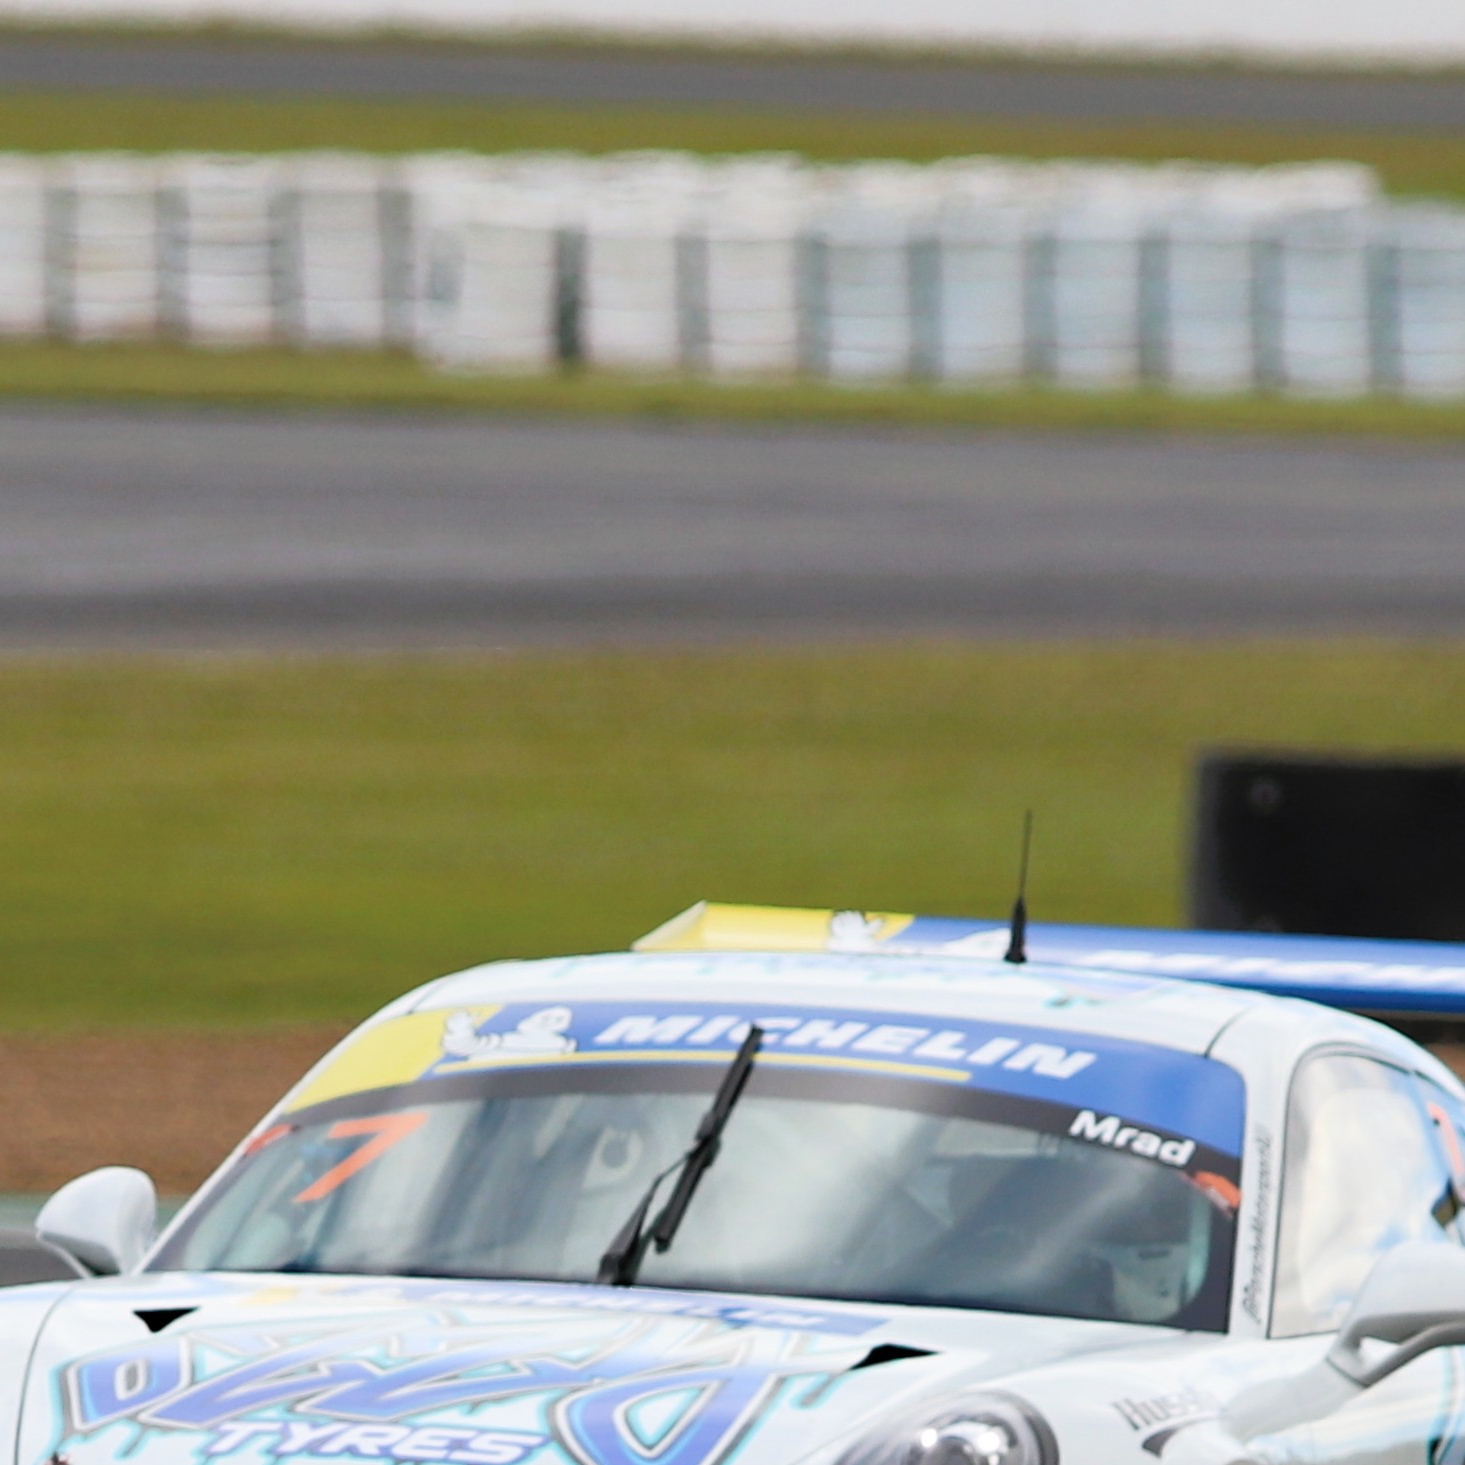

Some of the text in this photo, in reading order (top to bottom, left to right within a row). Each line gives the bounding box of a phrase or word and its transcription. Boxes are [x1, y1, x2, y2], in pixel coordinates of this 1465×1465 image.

[593, 1014, 1094, 1078] MICHELIN
[292, 1113, 423, 1203] 7
[1069, 1109, 1195, 1165] Mrad
[204, 1420, 535, 1465] TYRES
